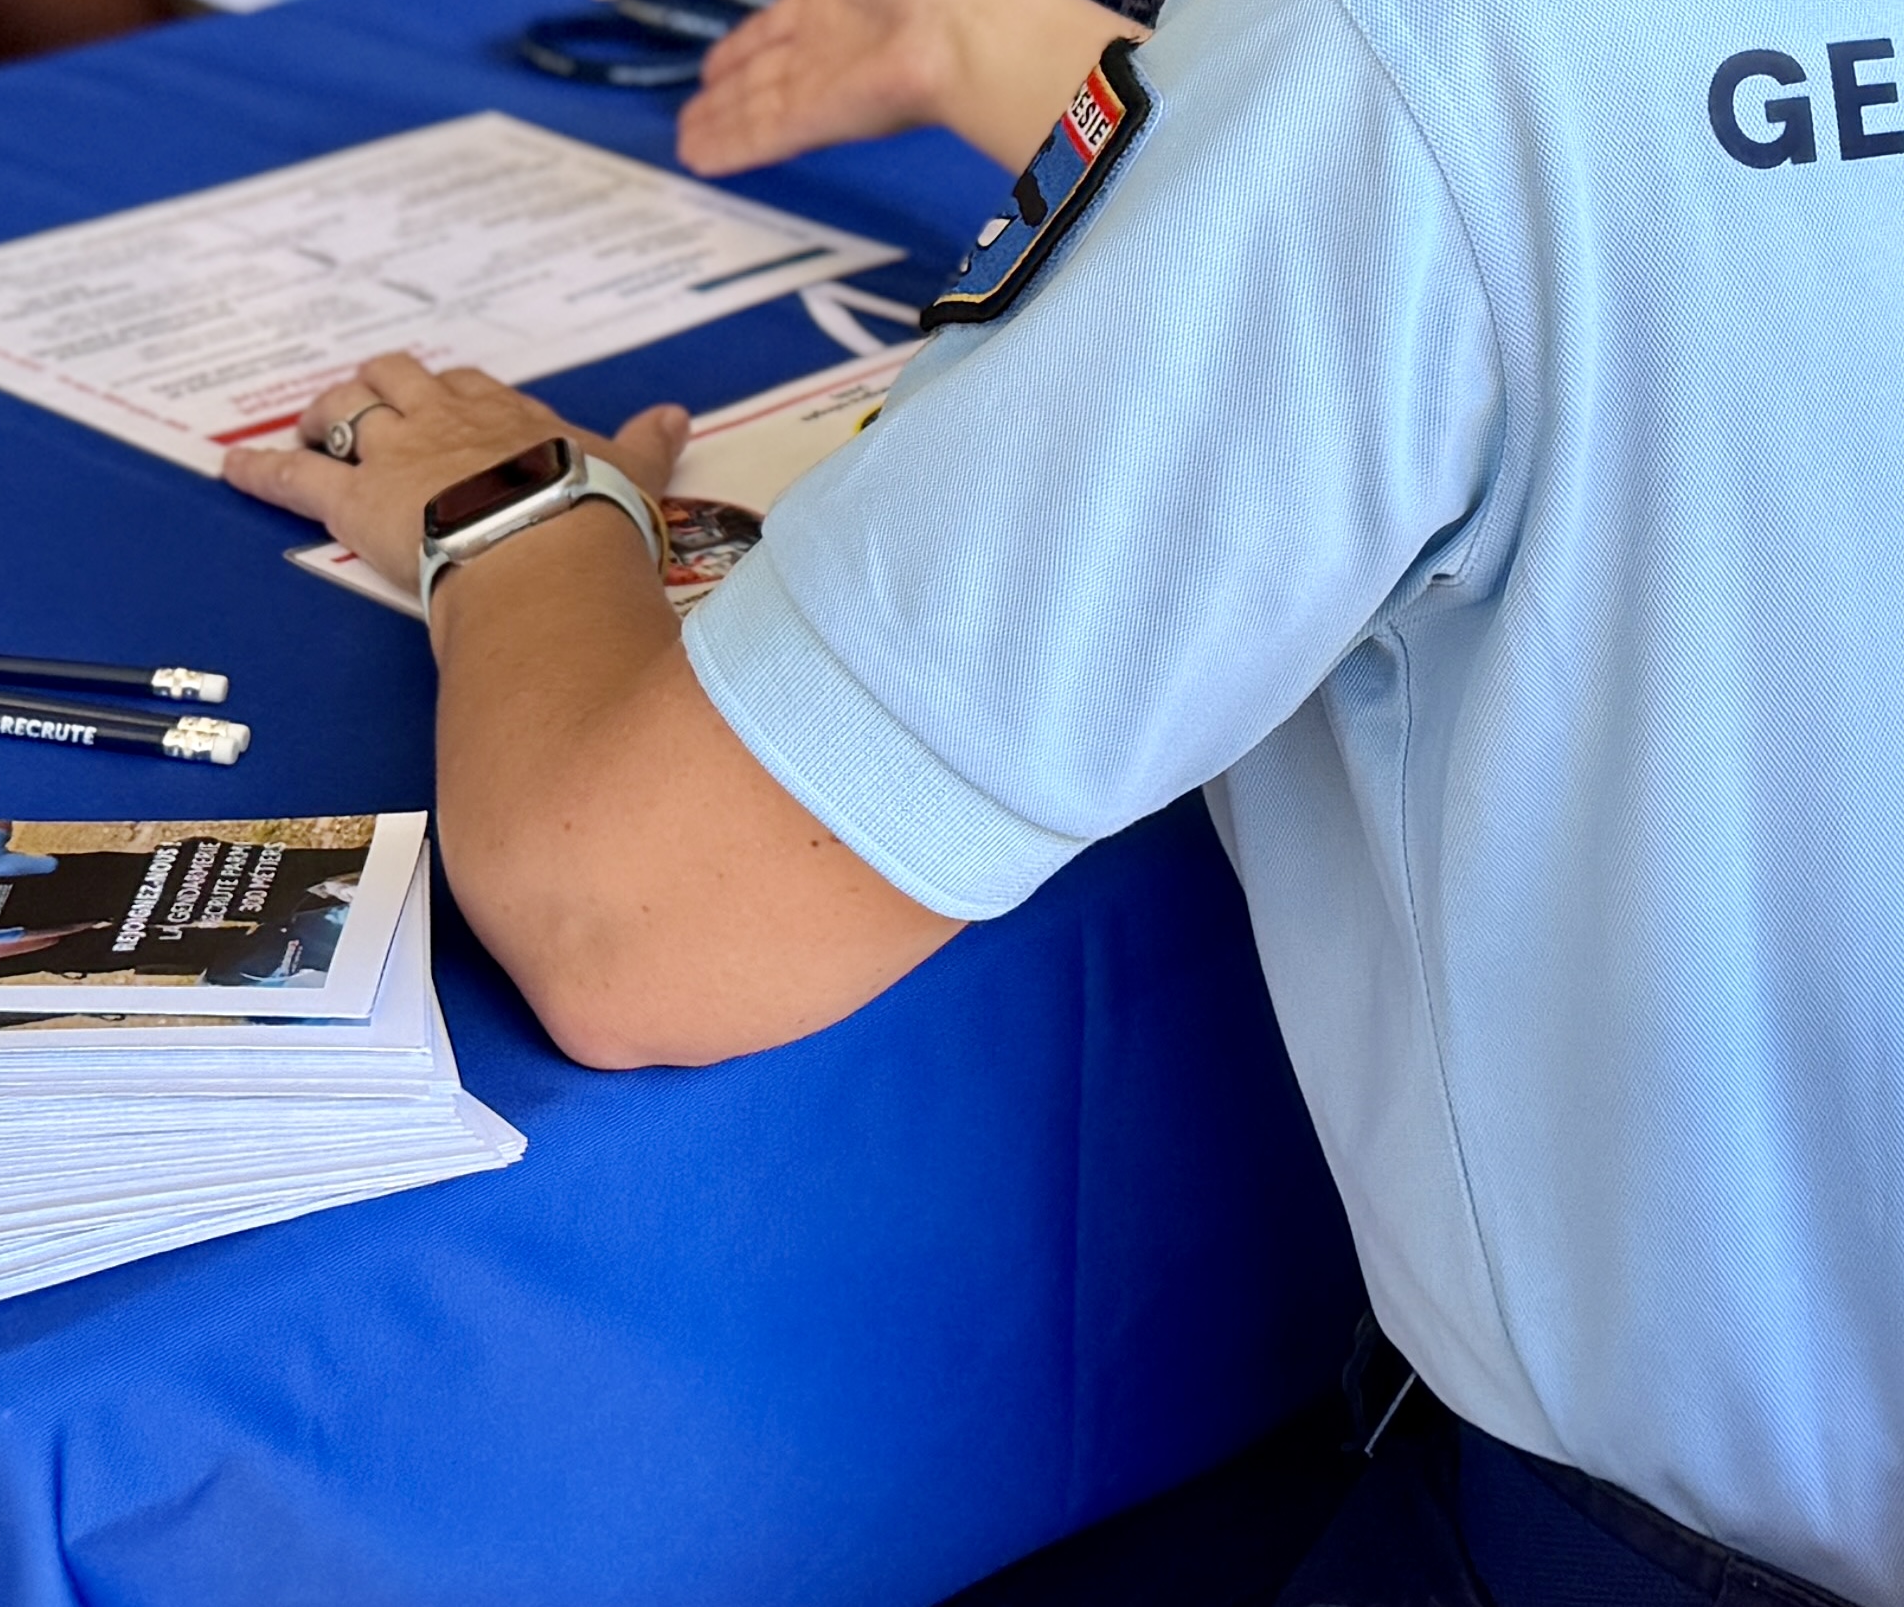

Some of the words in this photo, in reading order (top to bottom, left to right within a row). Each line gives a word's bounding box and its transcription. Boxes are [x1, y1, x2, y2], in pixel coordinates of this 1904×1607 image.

[1071, 90, 1112, 146] ESIE
[0, 715, 98, 745] RECRUTE
[167, 841, 222, 923] GENDARMERIE
[248, 840, 287, 890] MÉTIERS
[111, 847, 180, 952] REJOIGNEZ-NOUS
[239, 890, 268, 913] 300
